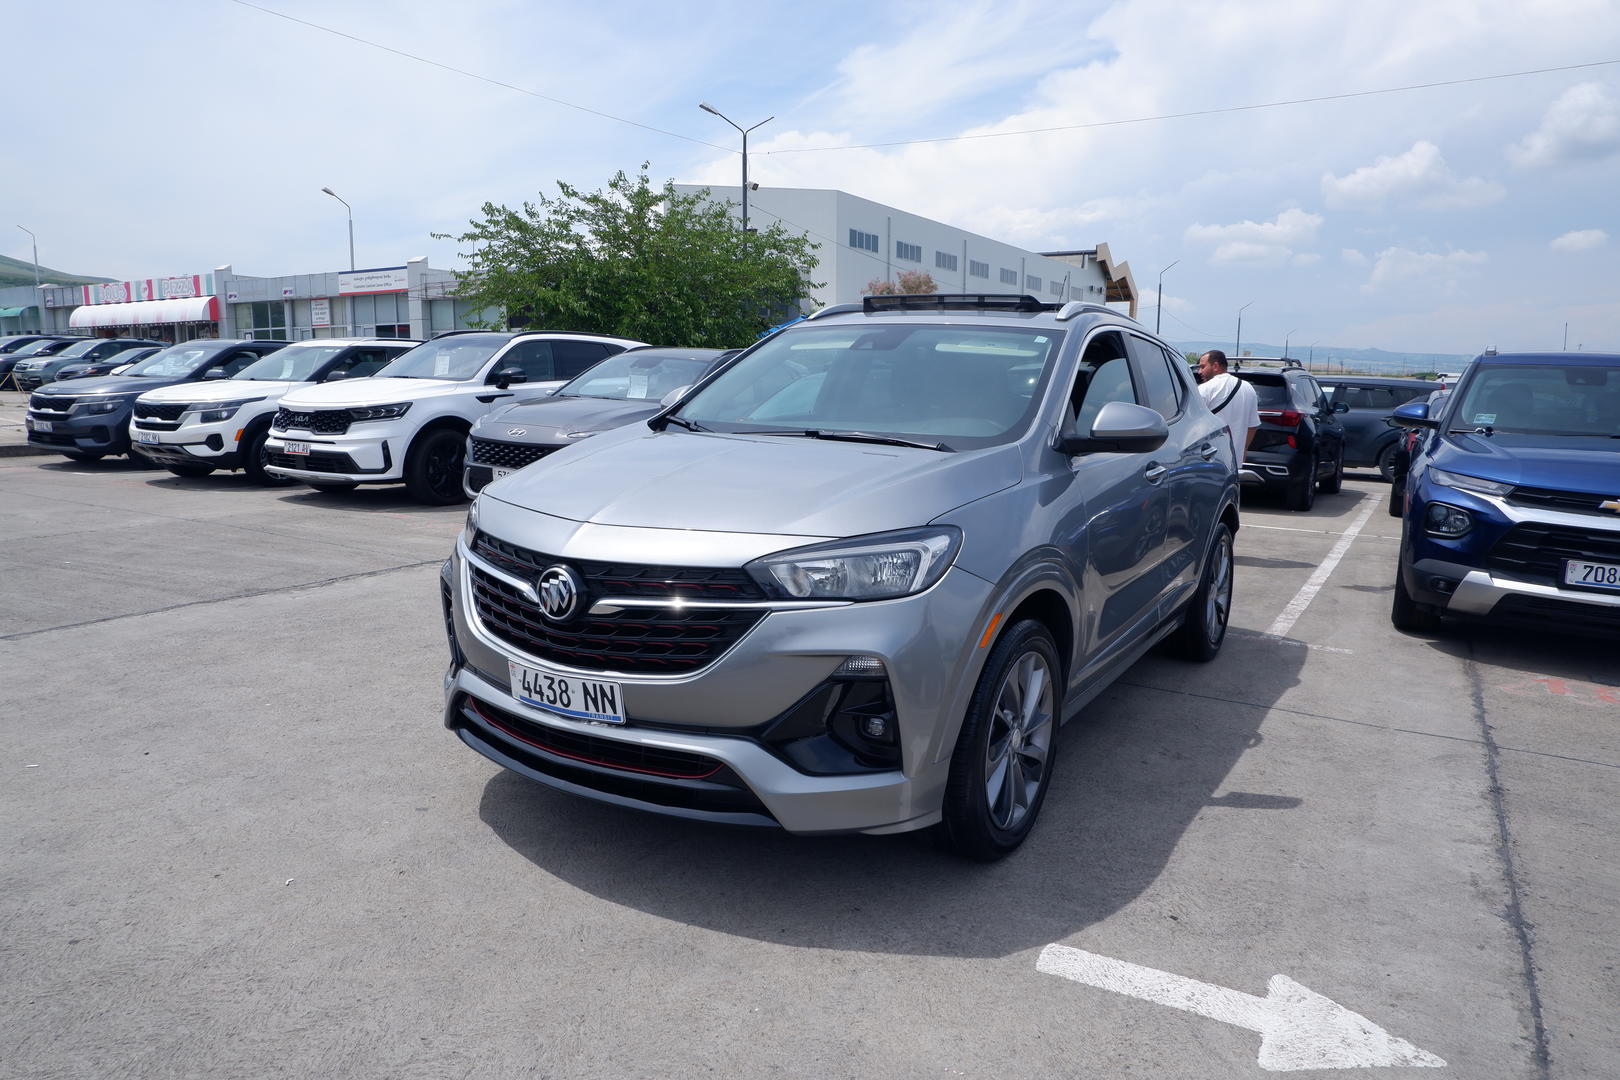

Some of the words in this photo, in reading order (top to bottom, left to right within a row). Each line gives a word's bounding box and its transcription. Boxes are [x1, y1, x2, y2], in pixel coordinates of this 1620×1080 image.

[162, 279, 196, 296] PIZZA
[1582, 565, 1620, 584] 708
[522, 669, 571, 708] 4438
[582, 682, 617, 714] NN
